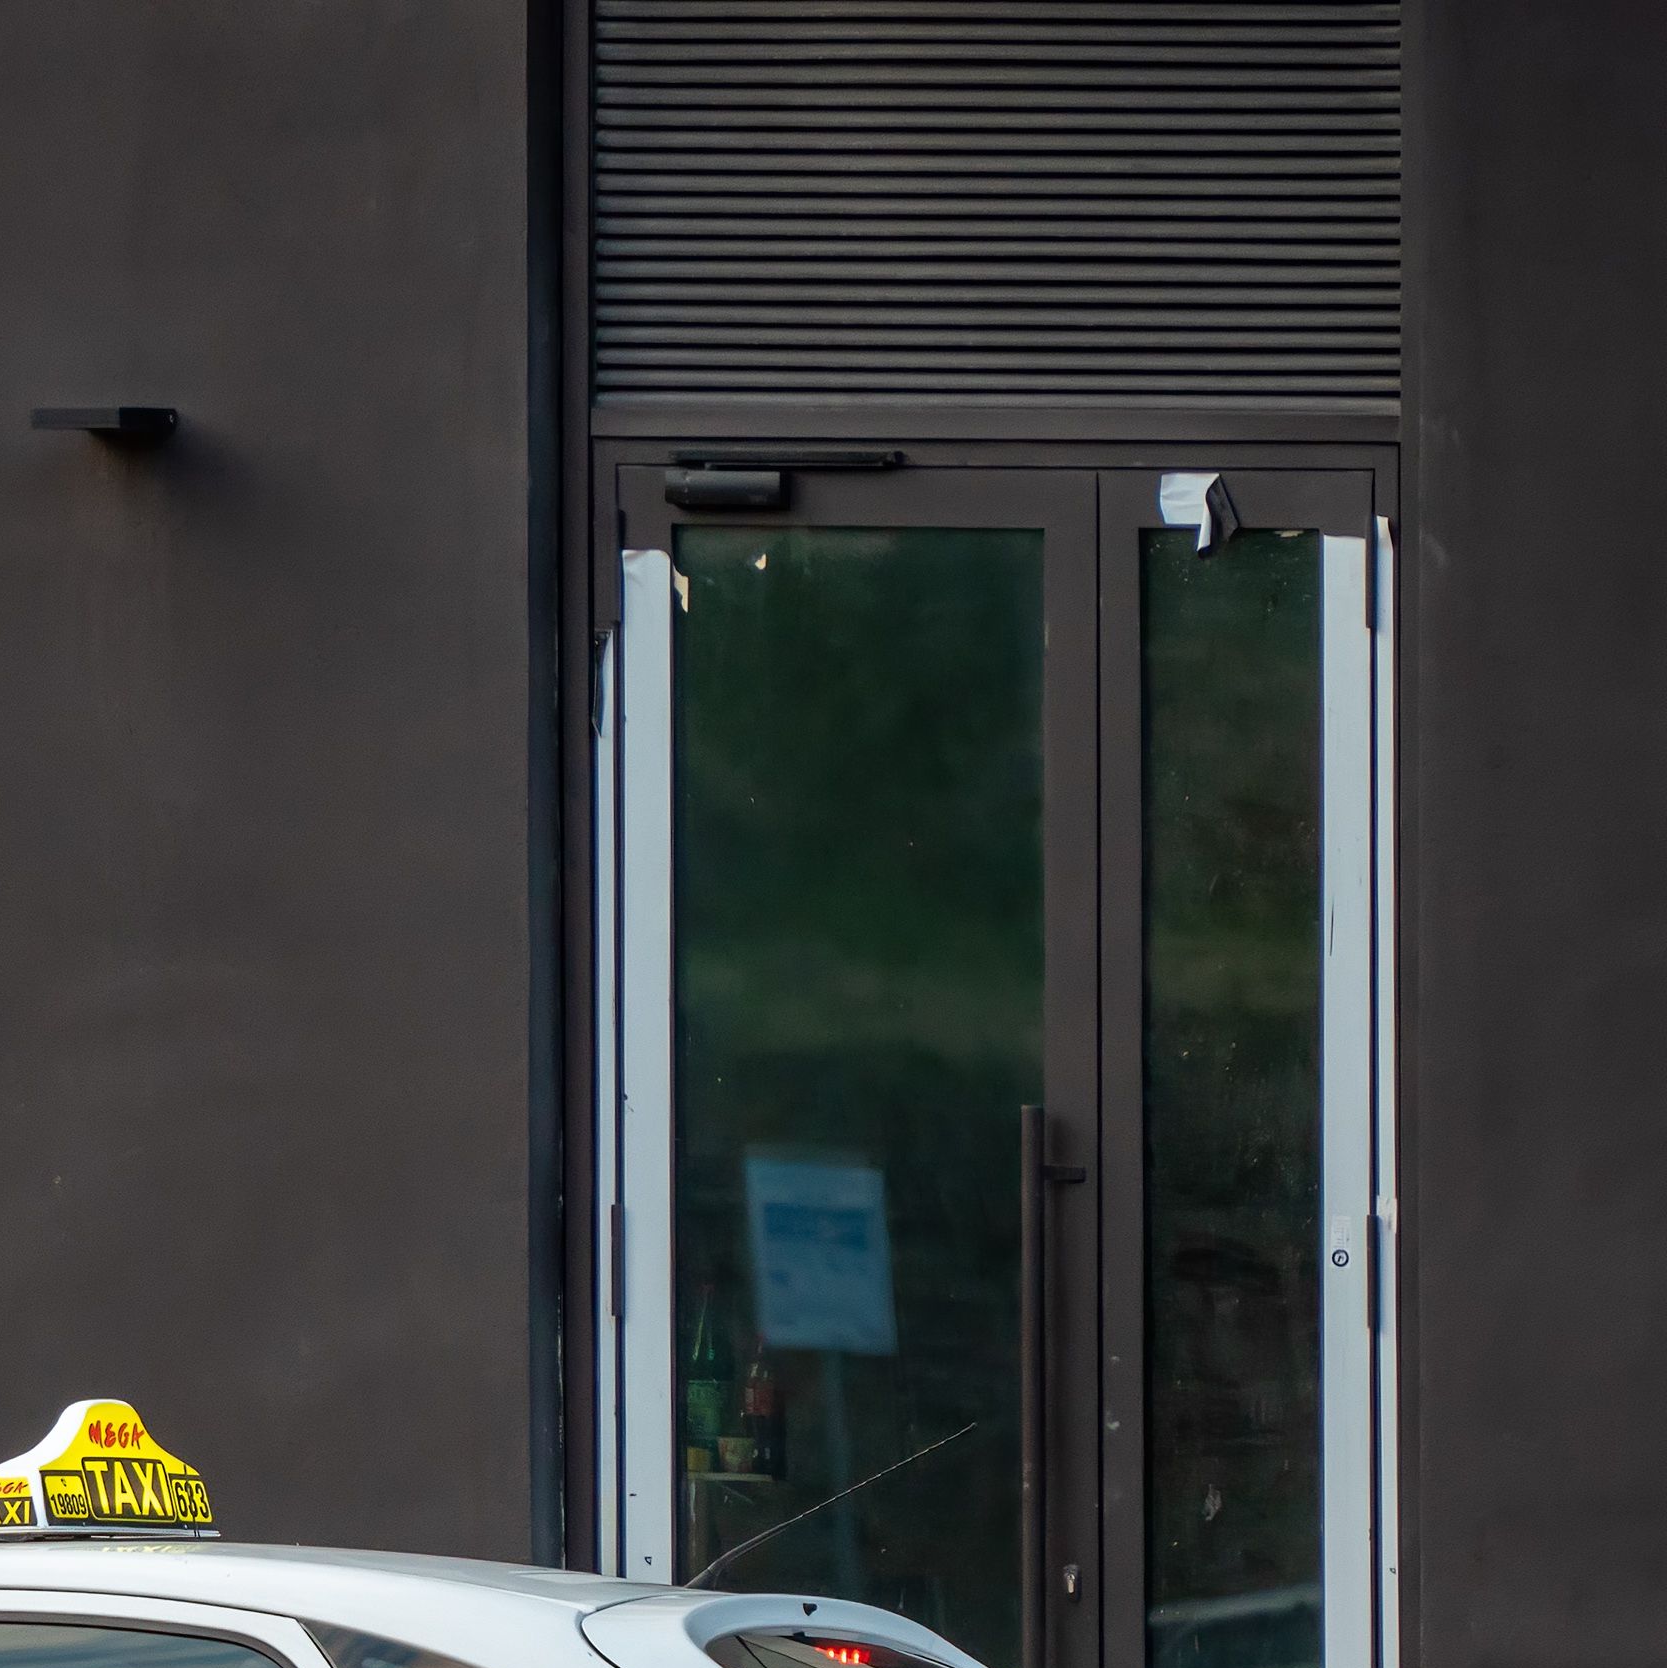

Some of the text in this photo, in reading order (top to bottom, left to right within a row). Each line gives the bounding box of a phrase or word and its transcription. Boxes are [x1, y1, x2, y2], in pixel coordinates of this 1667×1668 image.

[88, 1420, 145, 1449] MEGA
[83, 1460, 174, 1517] TAXI
[50, 1493, 87, 1516] 19809
